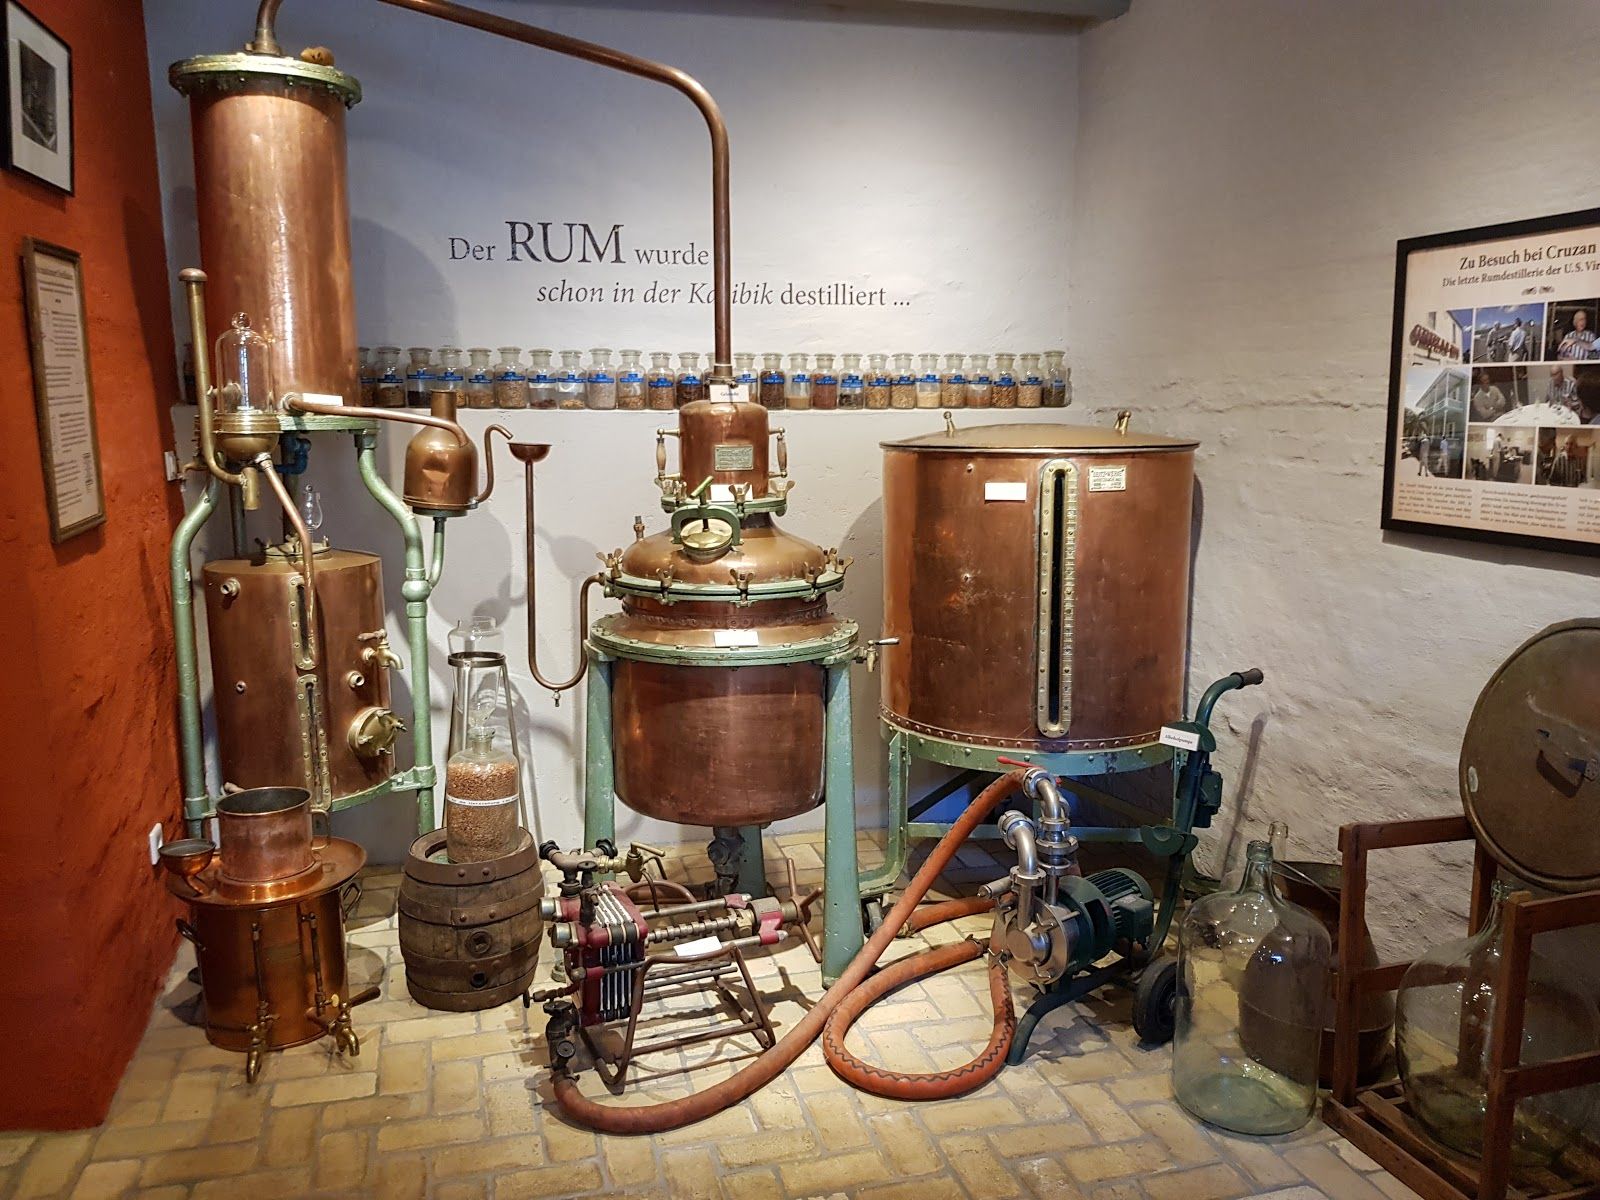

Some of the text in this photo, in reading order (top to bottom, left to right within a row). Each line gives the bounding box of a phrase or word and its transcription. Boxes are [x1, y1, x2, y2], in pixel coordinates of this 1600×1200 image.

[448, 220, 709, 266] Der RUM wurde
[1459, 243, 1597, 271] Zu Besuch bei Cruzan
[1442, 277, 1456, 288] Die
[1457, 274, 1480, 286] letzte
[1481, 267, 1544, 283] Rumdestillerie
[1545, 265, 1561, 276] der
[1564, 262, 1584, 274] U.S.
[536, 280, 604, 304] schon
[612, 281, 634, 304] in
[643, 281, 680, 304] der
[688, 282, 774, 305] Kaibik
[780, 282, 887, 306] destilliert
